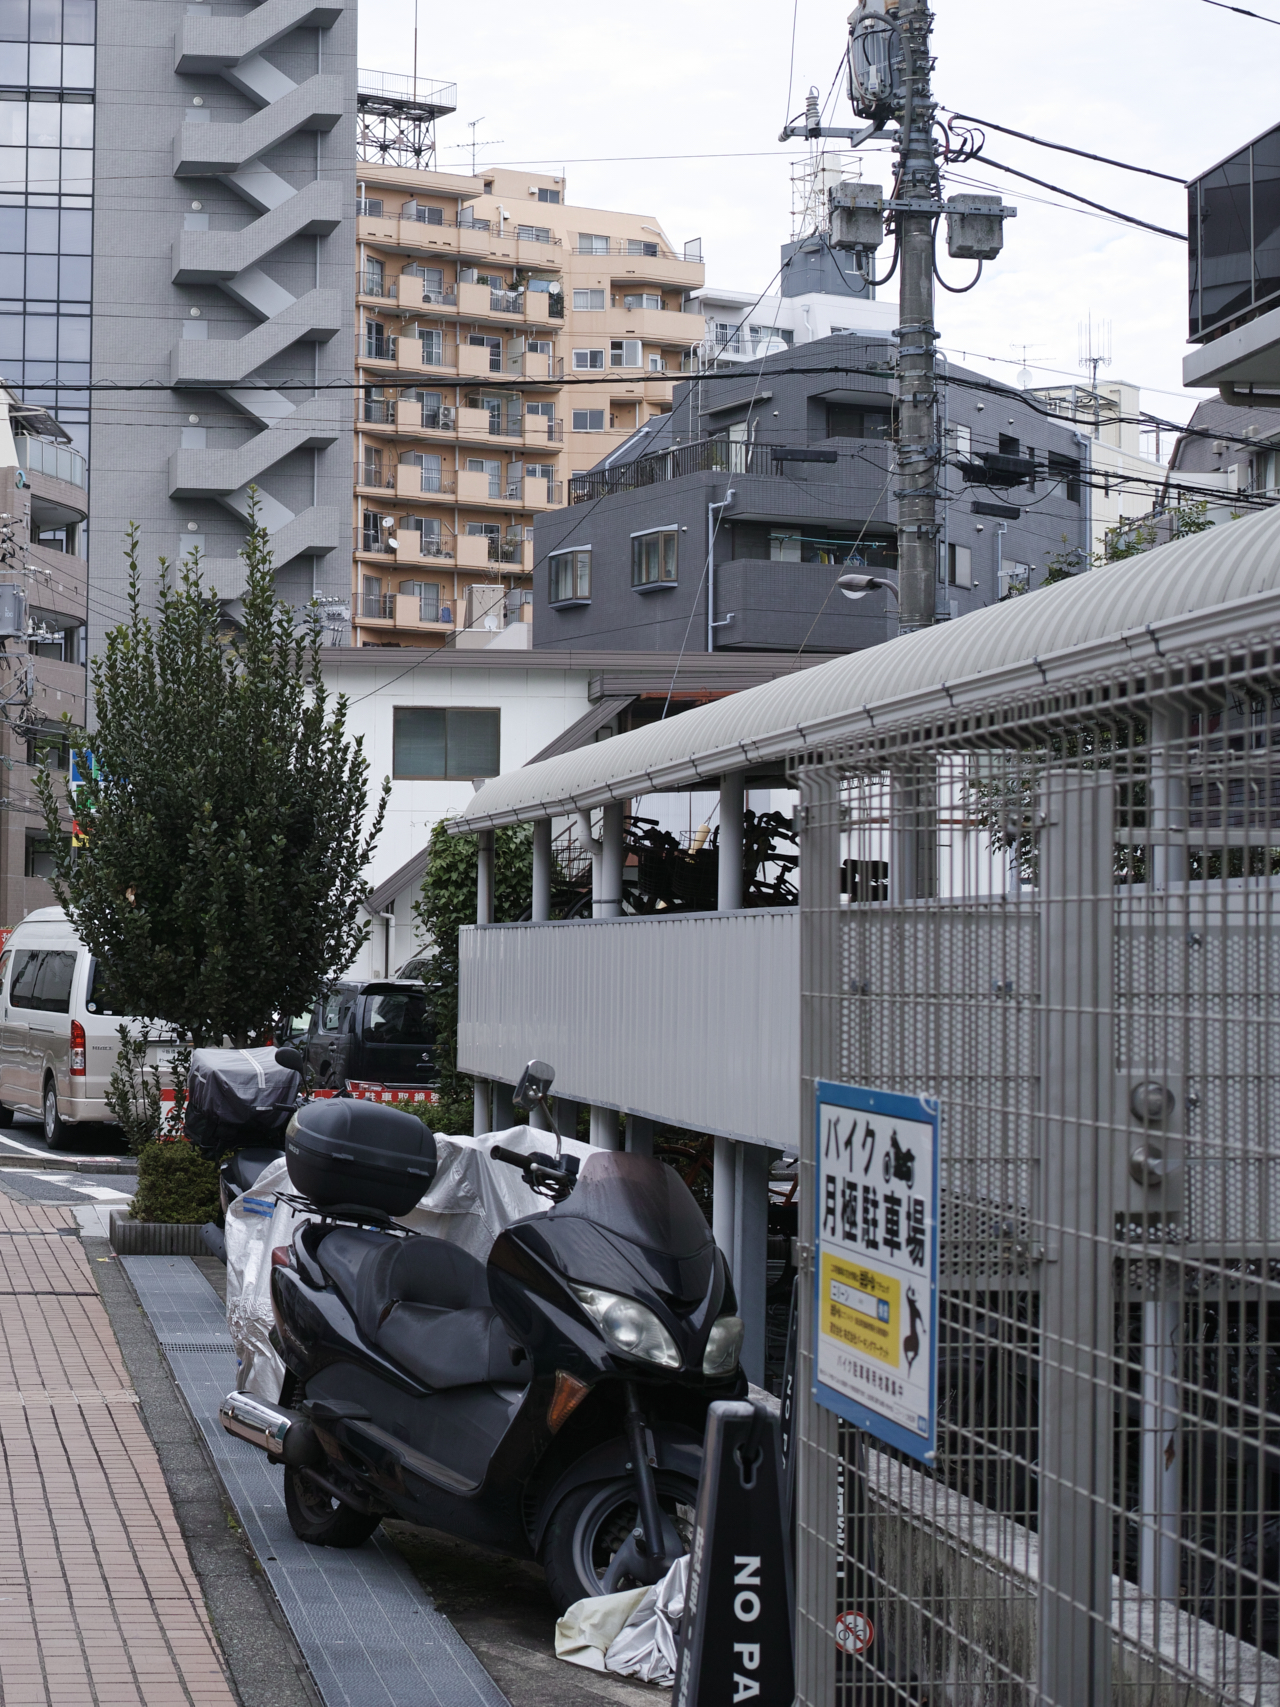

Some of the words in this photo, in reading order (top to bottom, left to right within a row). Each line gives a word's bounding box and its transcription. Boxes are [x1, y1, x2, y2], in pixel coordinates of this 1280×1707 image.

[825, 1114, 876, 1177] バイク
[822, 1174, 927, 1268] 月極駐車場
[784, 1373, 794, 1421] NO
[733, 1554, 762, 1623] NO
[732, 1642, 761, 1704] PA
